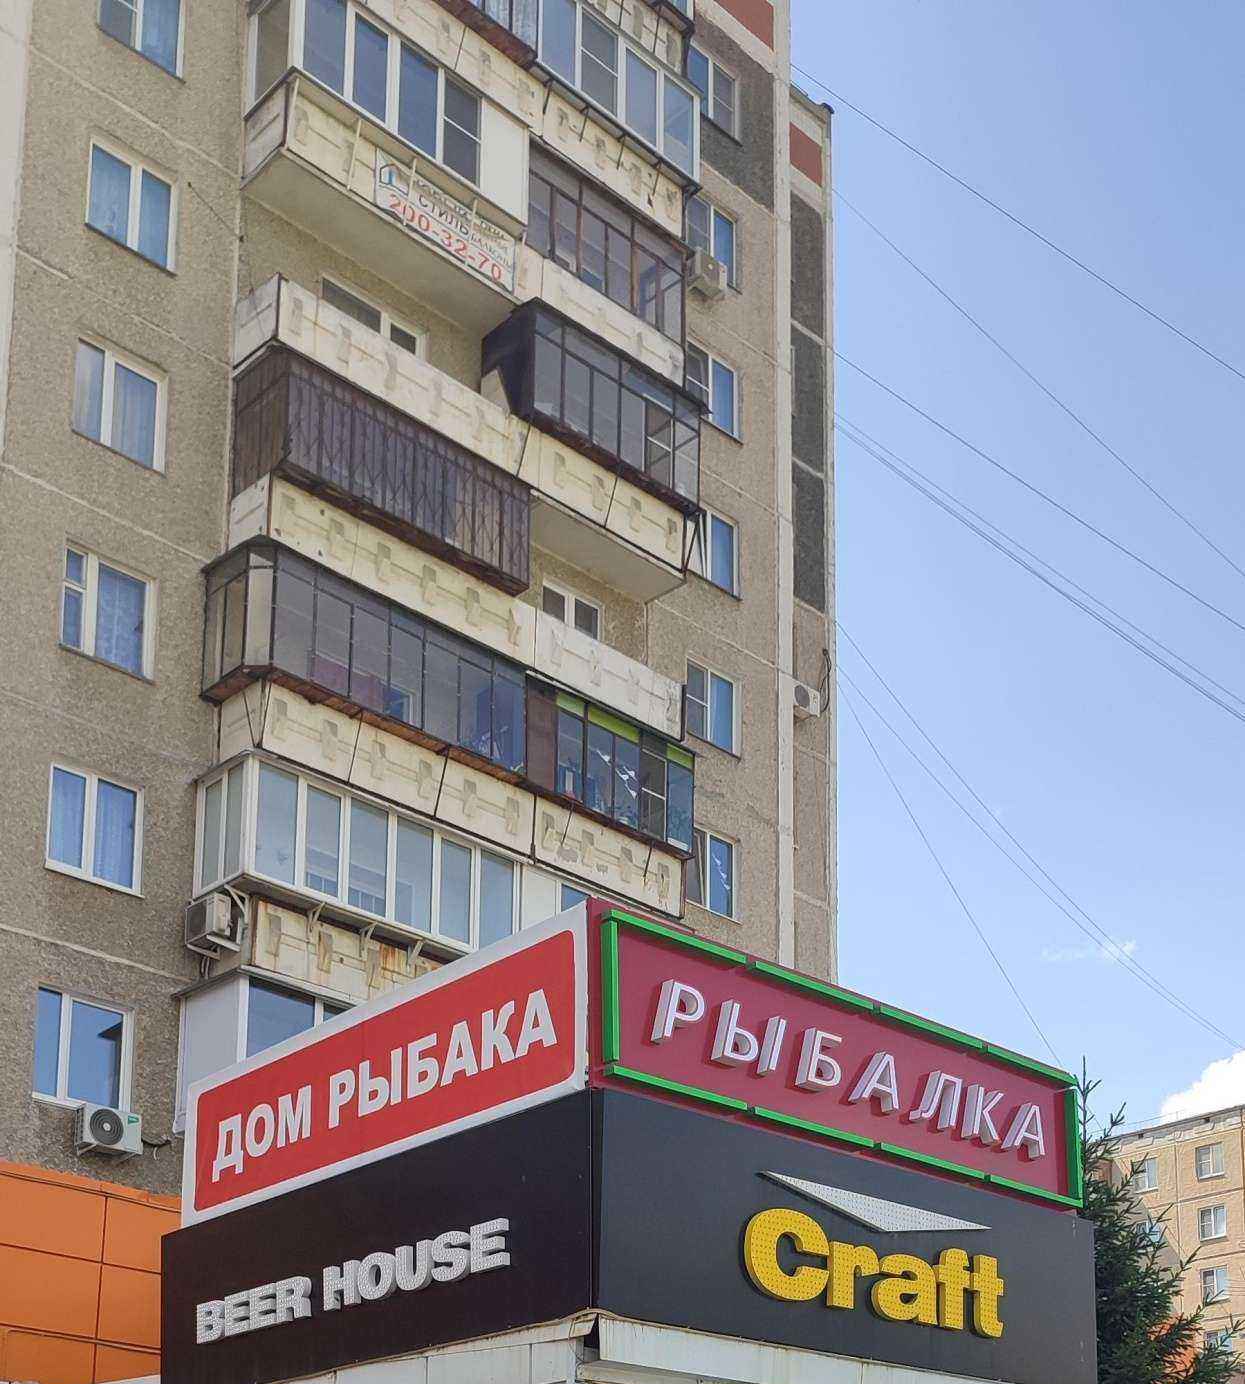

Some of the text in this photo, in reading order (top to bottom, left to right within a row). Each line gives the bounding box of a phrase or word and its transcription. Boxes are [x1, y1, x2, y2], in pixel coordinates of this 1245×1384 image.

[388, 192, 503, 282] 200-32-70
[211, 988, 558, 1182] ДОМ РЫБАКА
[650, 979, 1047, 1160] РЫБАЛКА
[196, 1217, 512, 1344] BEER HOUSE
[743, 1207, 1005, 1338] Craft
